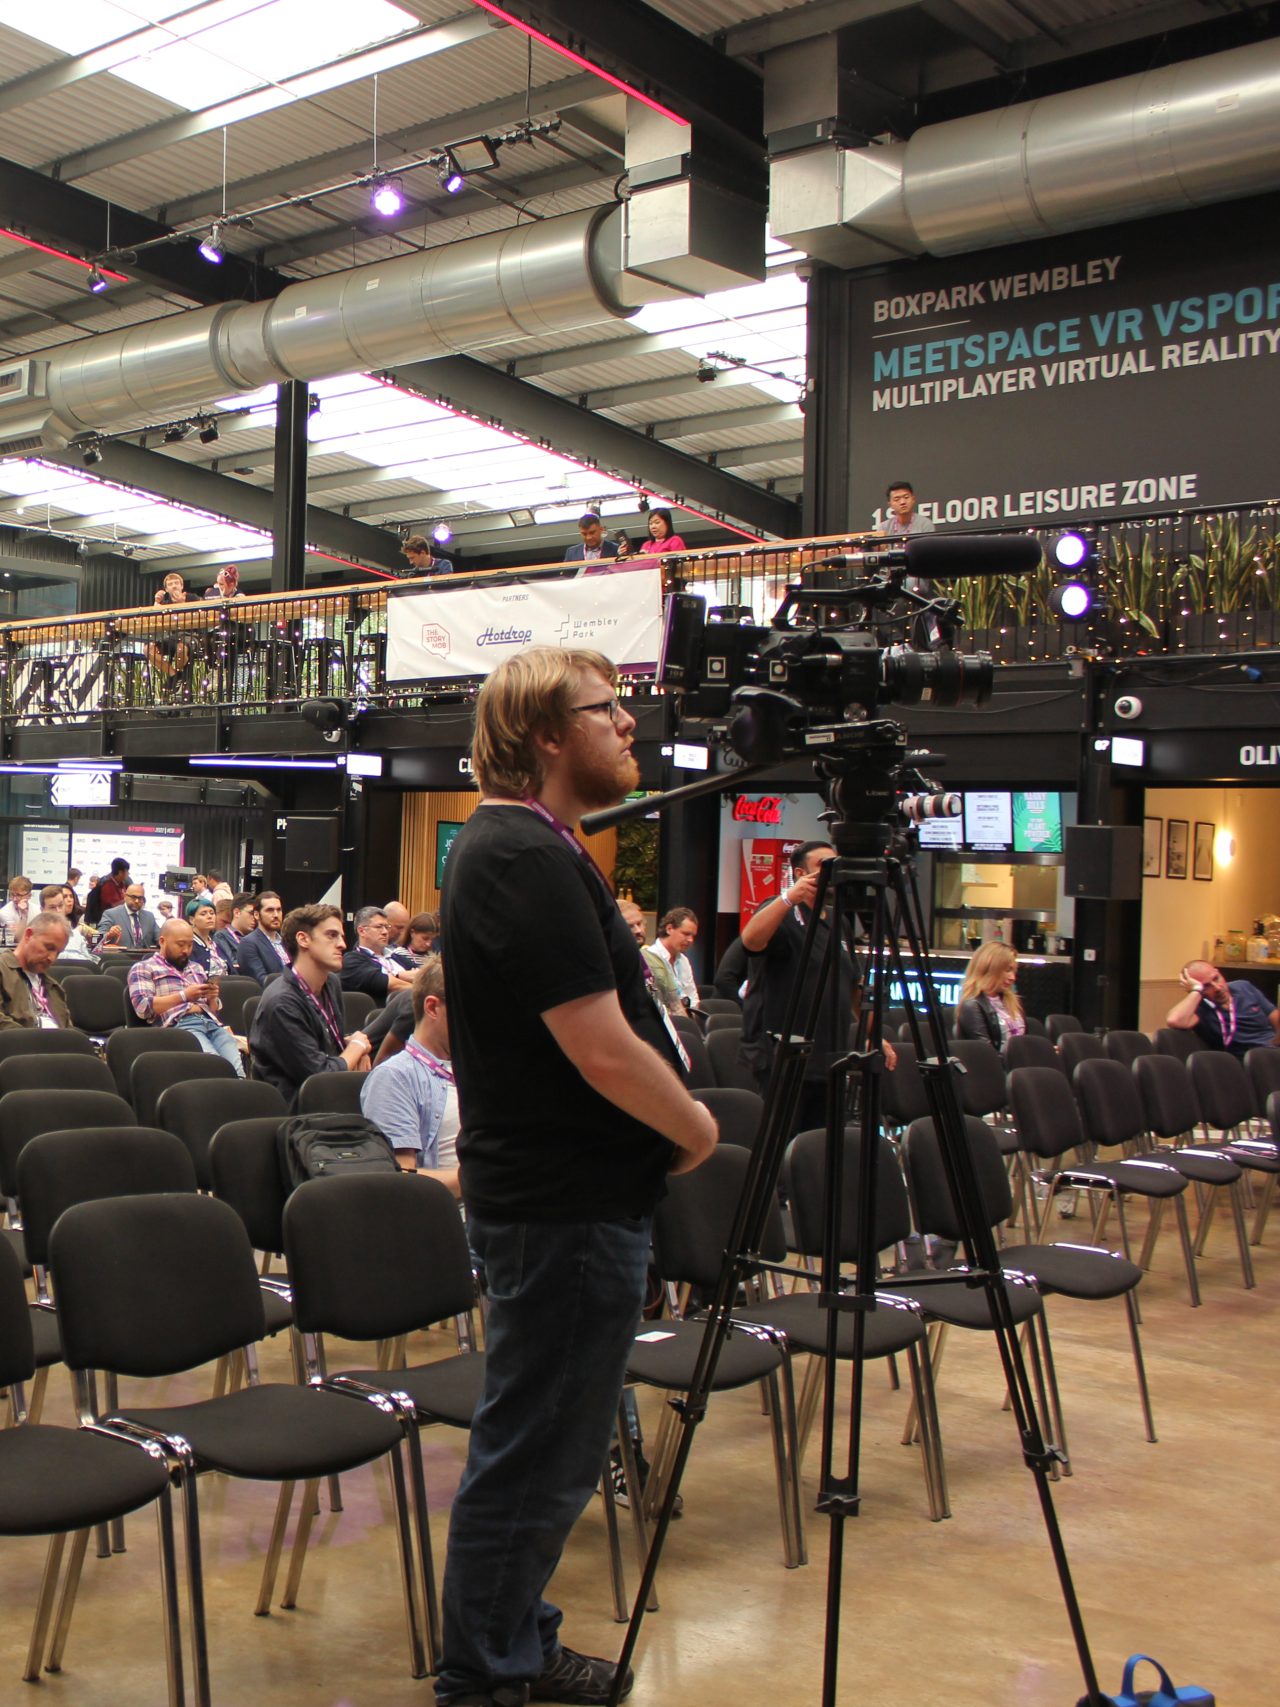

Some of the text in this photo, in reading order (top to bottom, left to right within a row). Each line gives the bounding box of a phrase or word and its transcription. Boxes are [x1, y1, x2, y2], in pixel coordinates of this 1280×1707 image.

[873, 255, 1122, 323] BOXPARK WEMBLEY
[873, 317, 1081, 382] MEETSPACE
[1090, 307, 1143, 347] VR
[872, 328, 1280, 412] MULTIPLAYER VIRTUAL REALITY
[918, 495, 998, 525] FLOOR
[1003, 482, 1117, 518] LEISURE
[1121, 473, 1198, 506] ZONE
[425, 635, 446, 643] STORY
[476, 626, 532, 647] Hotdrop
[572, 629, 595, 638] Park
[573, 617, 618, 629] Wembley
